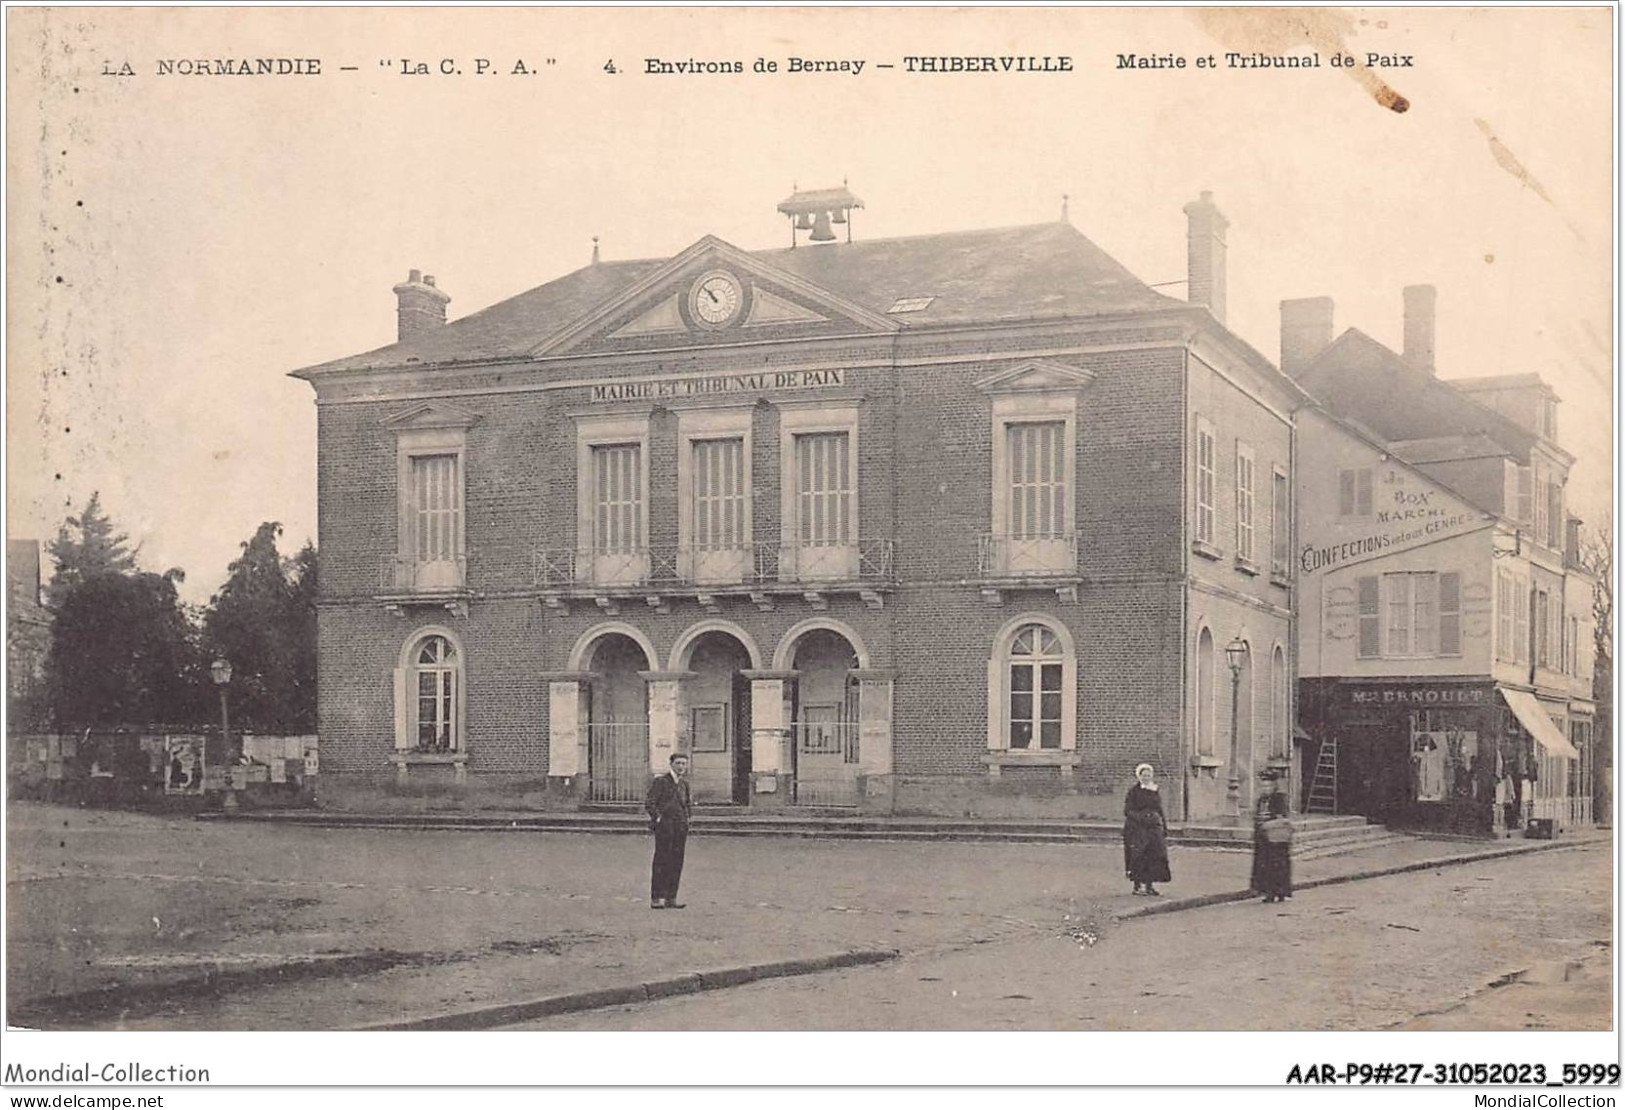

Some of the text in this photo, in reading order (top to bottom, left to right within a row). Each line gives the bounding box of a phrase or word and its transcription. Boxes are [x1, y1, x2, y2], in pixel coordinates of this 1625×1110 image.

[593, 369, 842, 401] MAIRIE ET TRIBUNAL DE PAIX
[1425, 512, 1474, 534] GENRES
